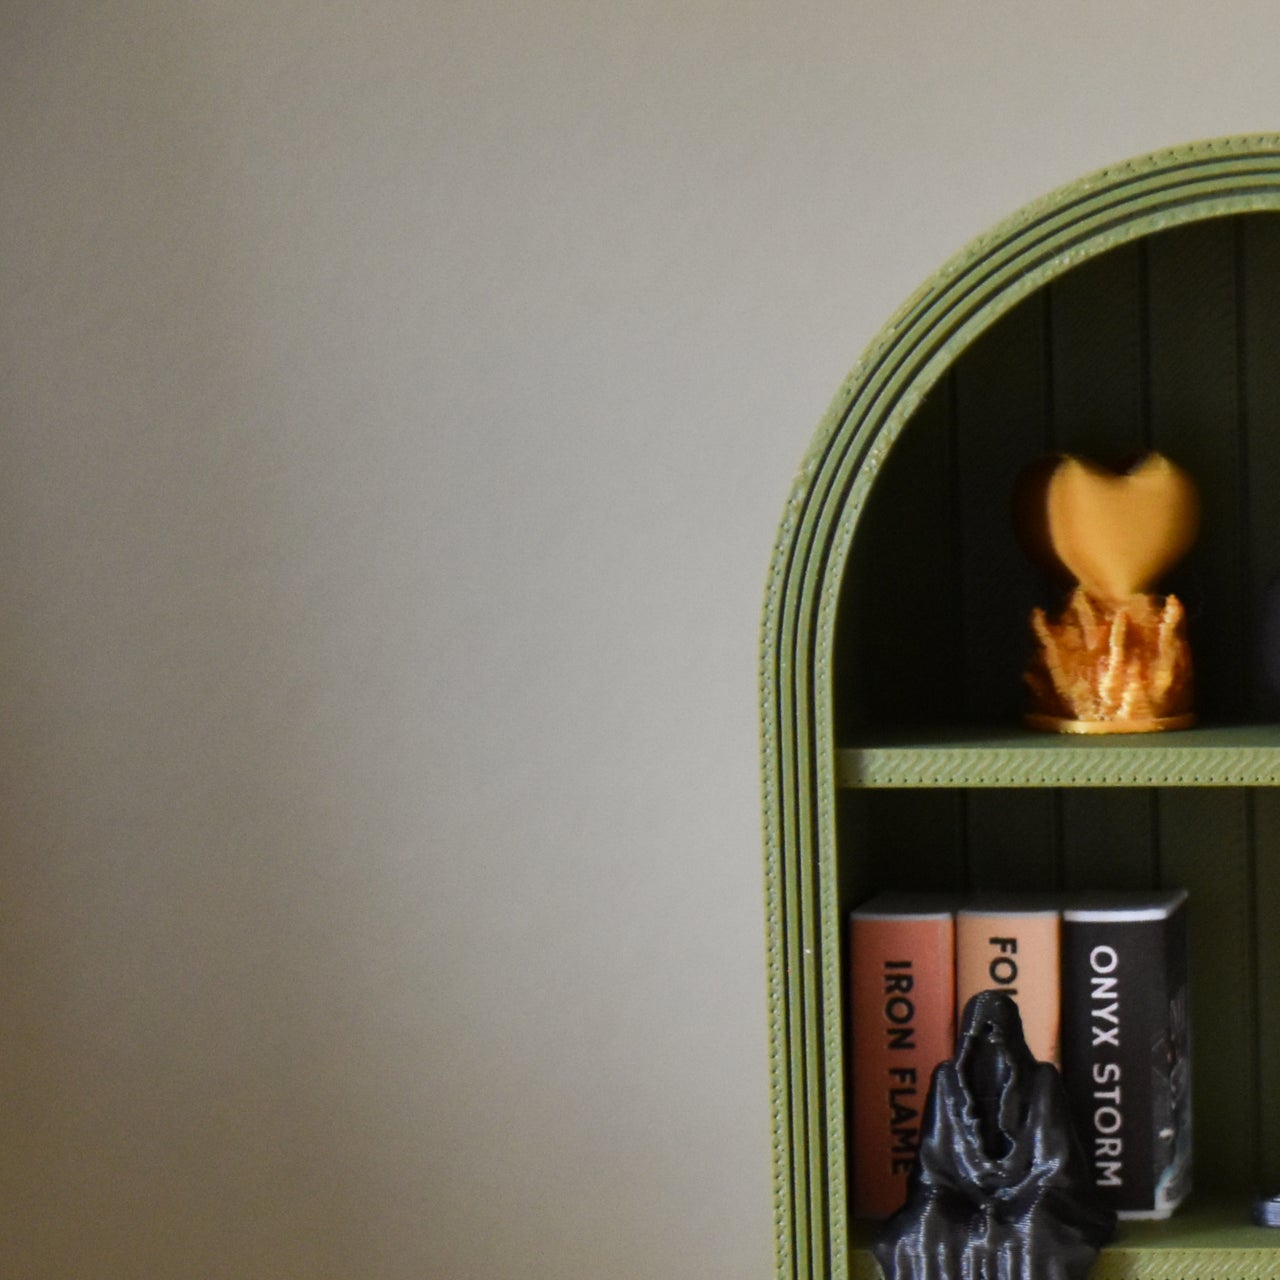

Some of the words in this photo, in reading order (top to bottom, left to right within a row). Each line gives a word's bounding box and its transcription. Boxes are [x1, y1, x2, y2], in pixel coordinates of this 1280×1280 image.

[883, 959, 916, 1051] IRON
[1089, 944, 1120, 1047] ONYX
[888, 1066, 919, 1176] FLAME
[1092, 1062, 1123, 1188] STORM
